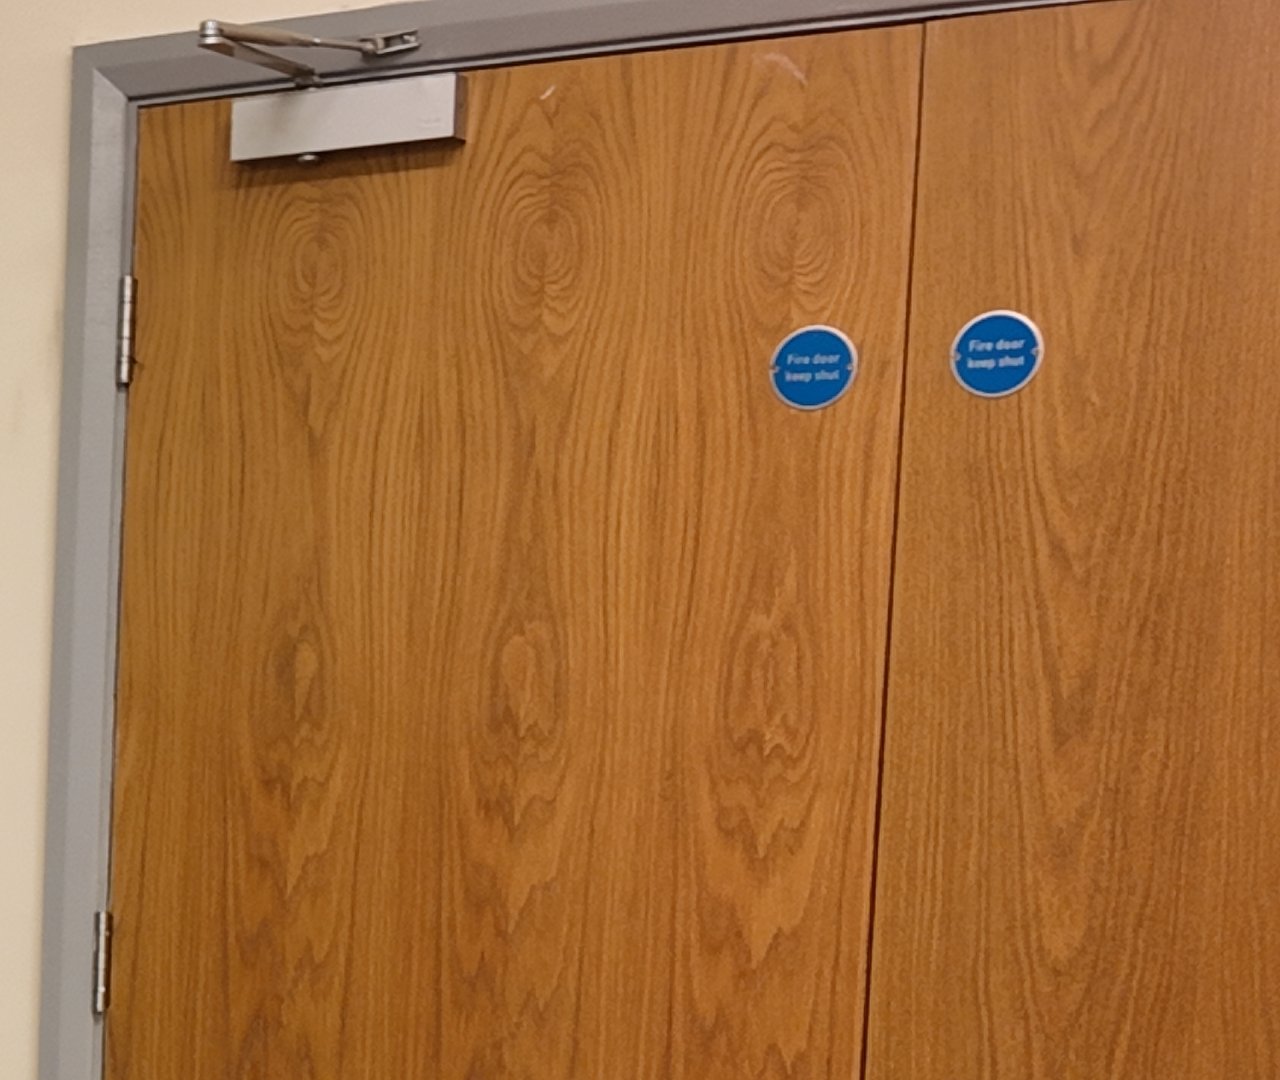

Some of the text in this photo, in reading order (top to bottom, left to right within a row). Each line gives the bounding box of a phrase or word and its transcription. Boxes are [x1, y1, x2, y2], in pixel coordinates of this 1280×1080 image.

[968, 336, 1026, 353] Fire door
[786, 352, 841, 366] Fire door
[965, 355, 1026, 371] keep shut
[784, 368, 841, 384] keep shut
